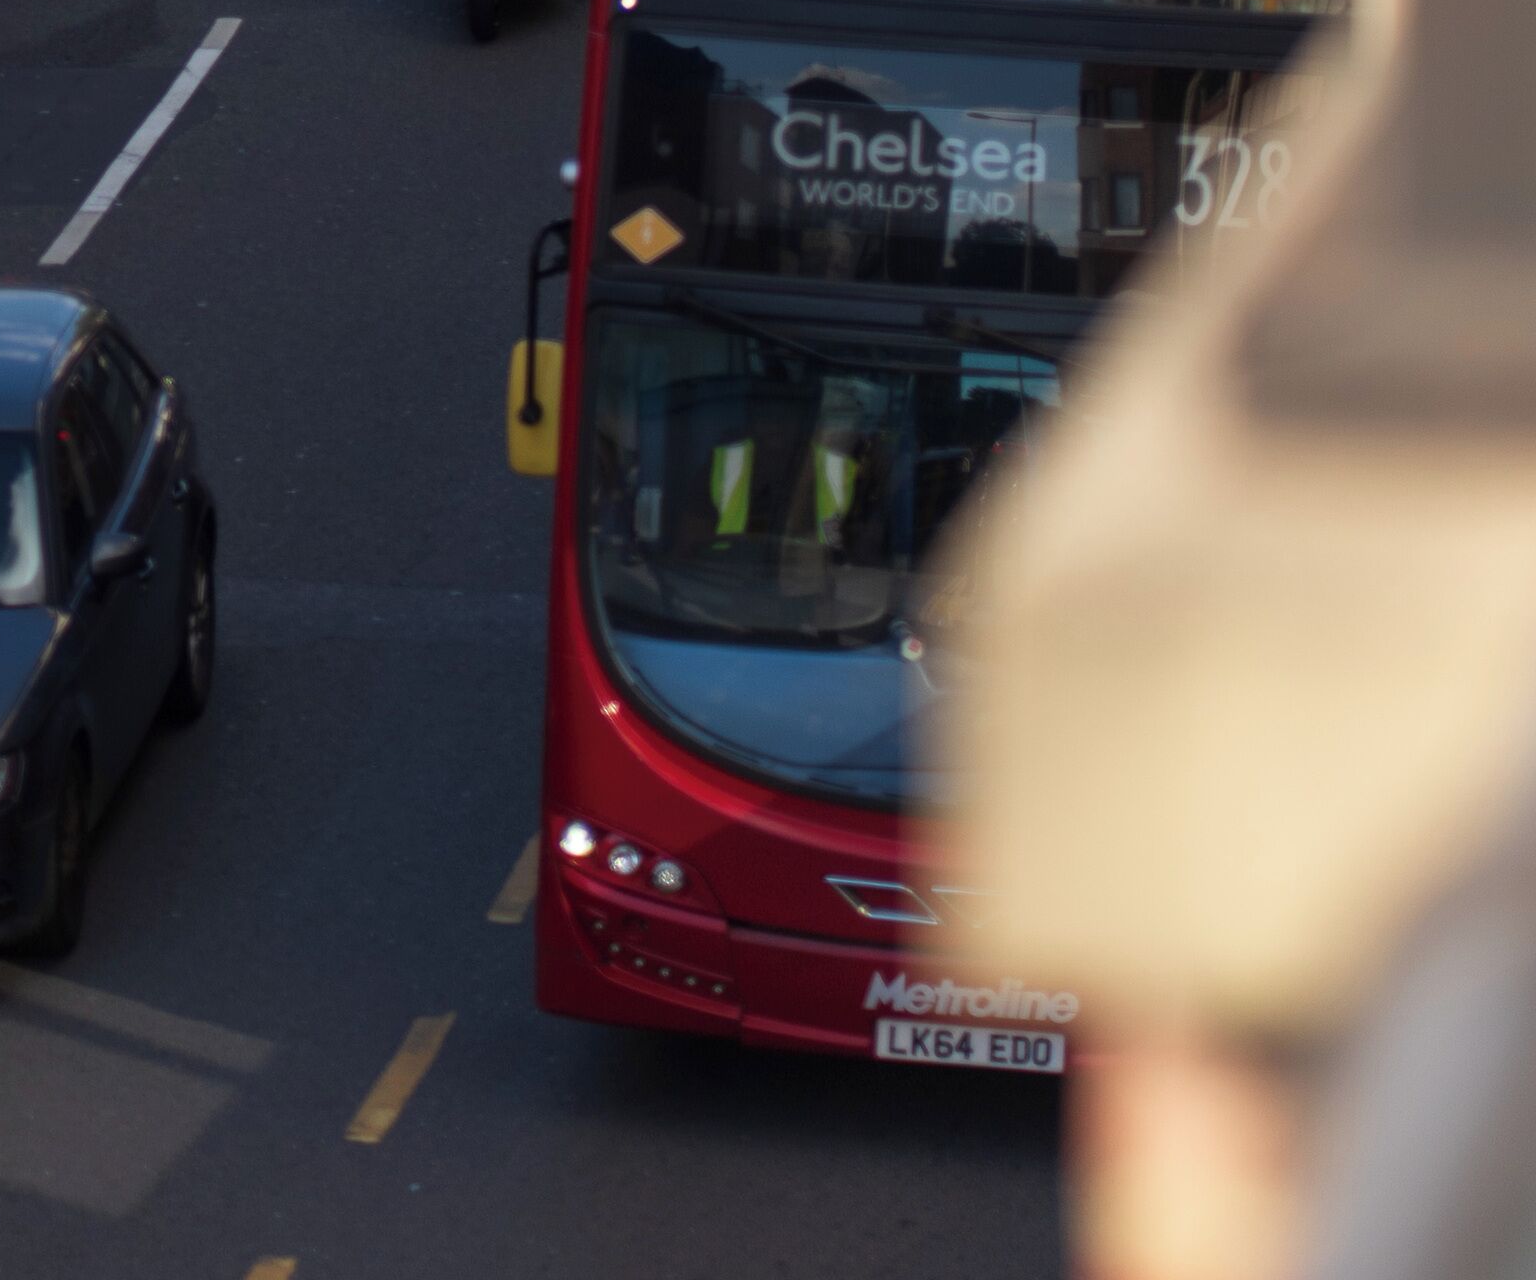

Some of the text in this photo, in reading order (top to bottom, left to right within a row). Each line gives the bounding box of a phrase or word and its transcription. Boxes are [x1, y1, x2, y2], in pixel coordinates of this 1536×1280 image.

[772, 110, 1046, 182] Chelsea
[799, 178, 1015, 218] WORLD'S END
[1175, 134, 1293, 229] 328
[863, 970, 1079, 1024] Metroline
[889, 1025, 1052, 1066] LK64 EDO
